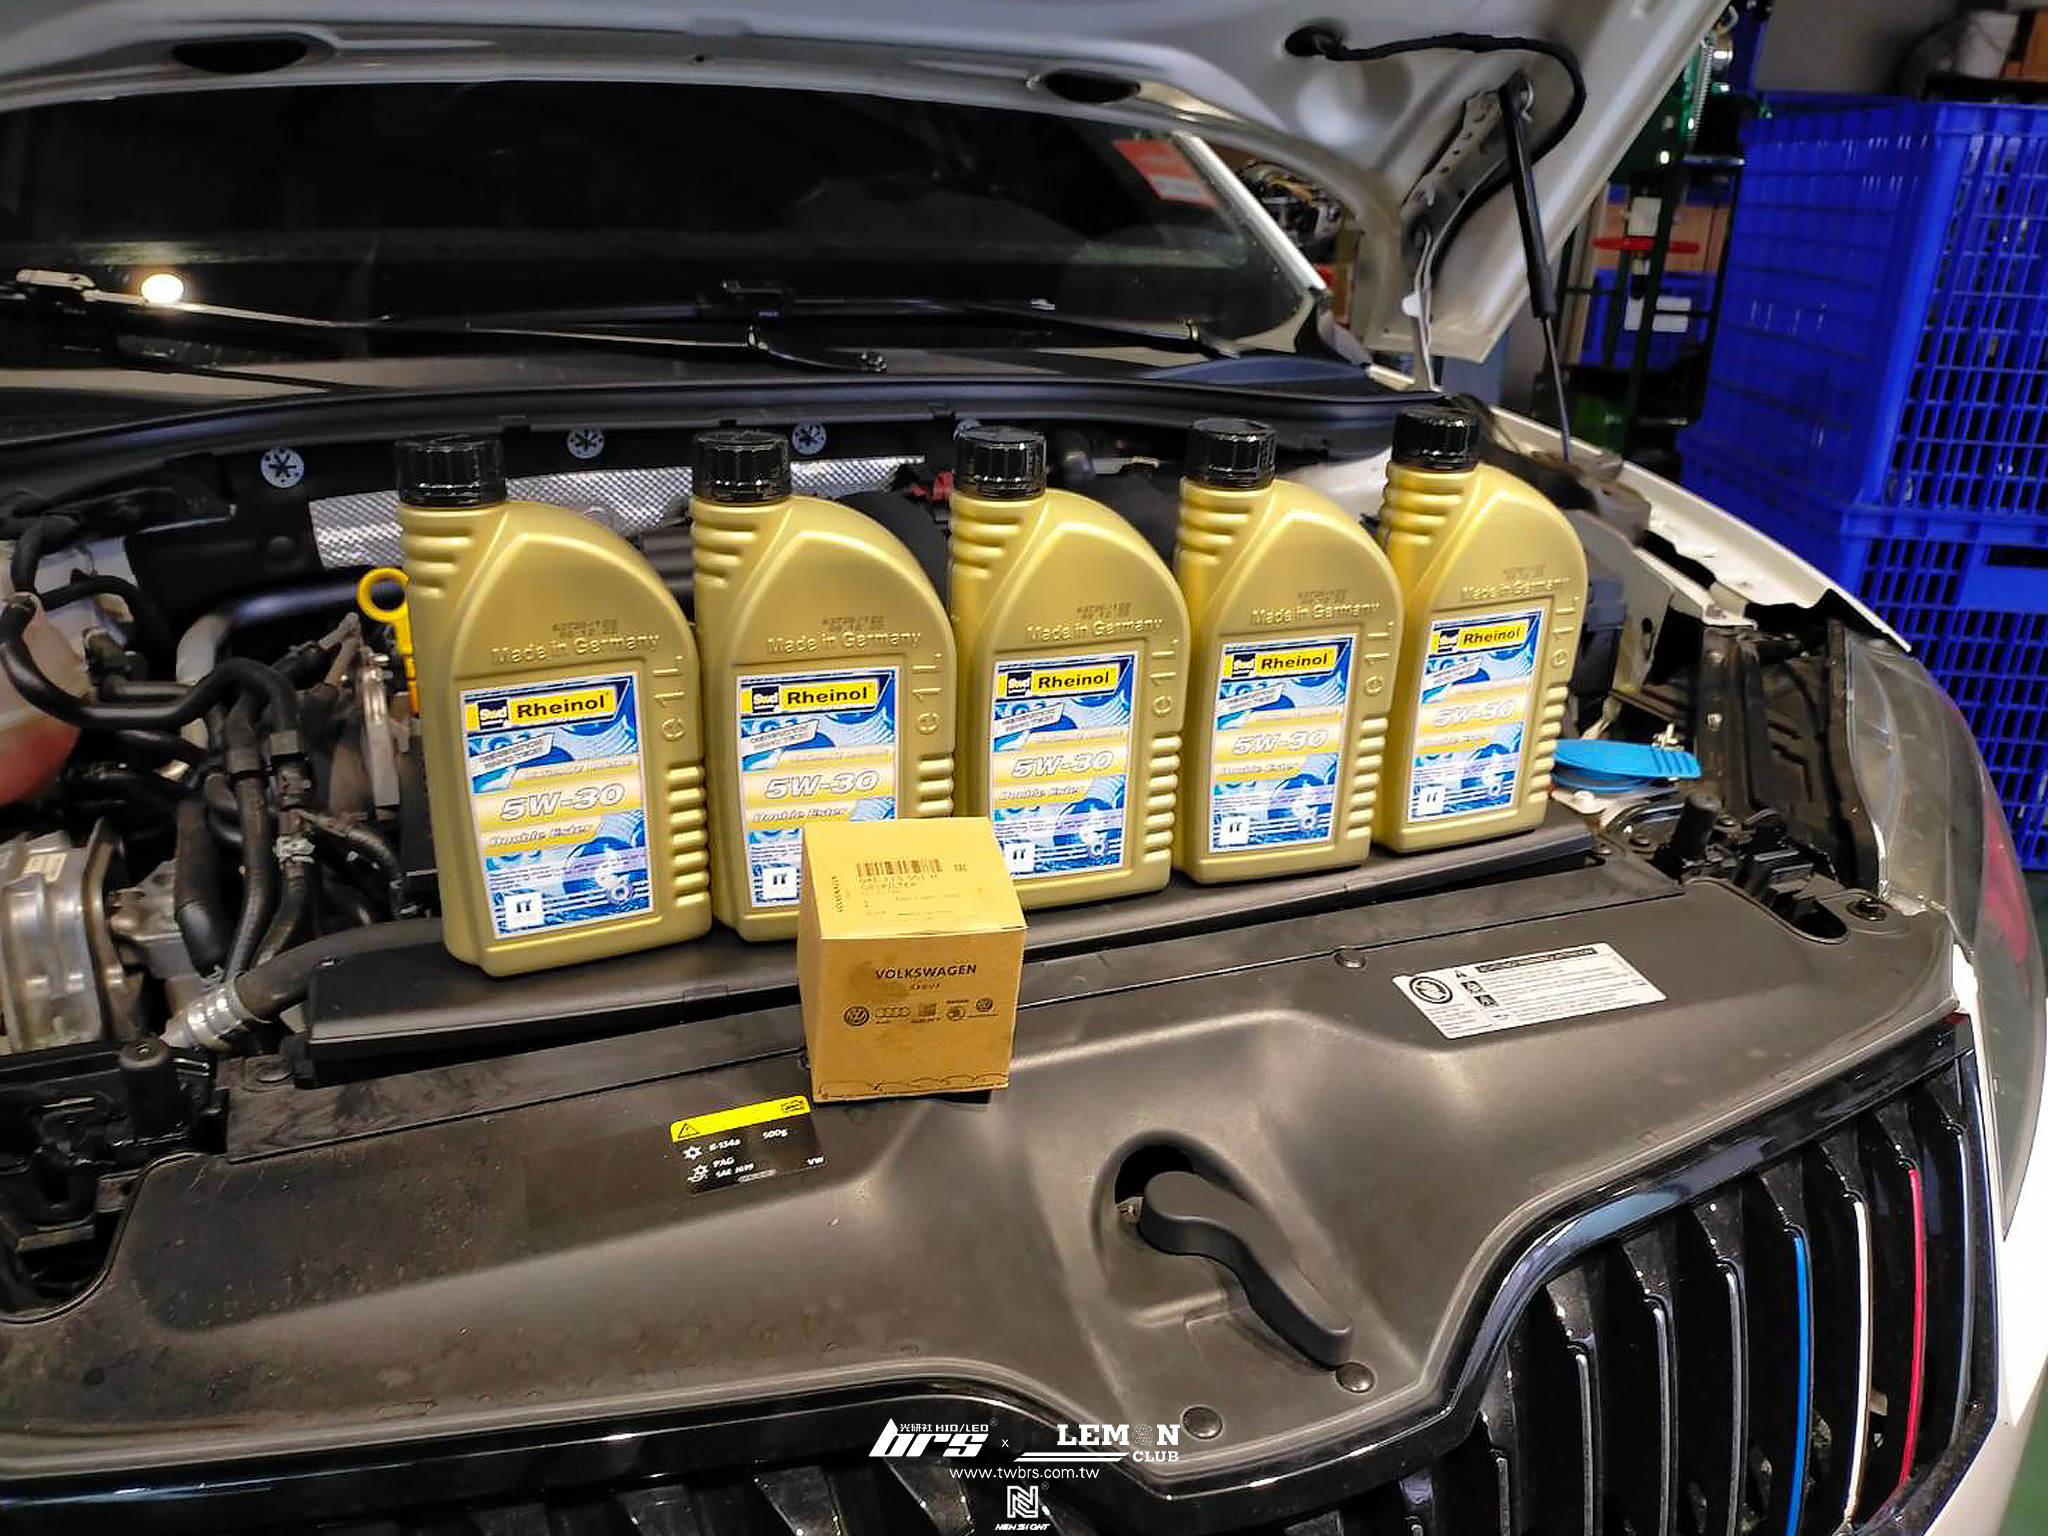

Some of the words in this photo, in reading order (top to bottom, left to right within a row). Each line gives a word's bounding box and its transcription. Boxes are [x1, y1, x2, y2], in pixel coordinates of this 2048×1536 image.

[1252, 608, 1292, 624] Made
[1296, 607, 1308, 618] in
[1313, 601, 1380, 619] Germany
[1027, 624, 1070, 641] Made
[1074, 623, 1087, 635] in
[1093, 618, 1163, 635] Germany
[1463, 628, 1520, 645] Rheinol
[491, 646, 546, 663] Made
[551, 642, 567, 656] in
[573, 633, 660, 654] Germany
[766, 635, 817, 653] Made
[821, 633, 837, 648] in
[842, 630, 921, 648] Germany
[1261, 653, 1327, 671] Rheinol
[1038, 672, 1110, 689] Rheinol
[517, 695, 605, 718] Rheinol
[787, 687, 867, 705] Rheinol
[1435, 699, 1516, 727] 5W-30
[1233, 730, 1327, 755] 5W-30
[1011, 750, 1114, 778] 5W-30
[765, 770, 880, 799] 5W-30
[500, 783, 625, 821] 5W-30
[875, 964, 977, 979] VOLKSWAGEN
